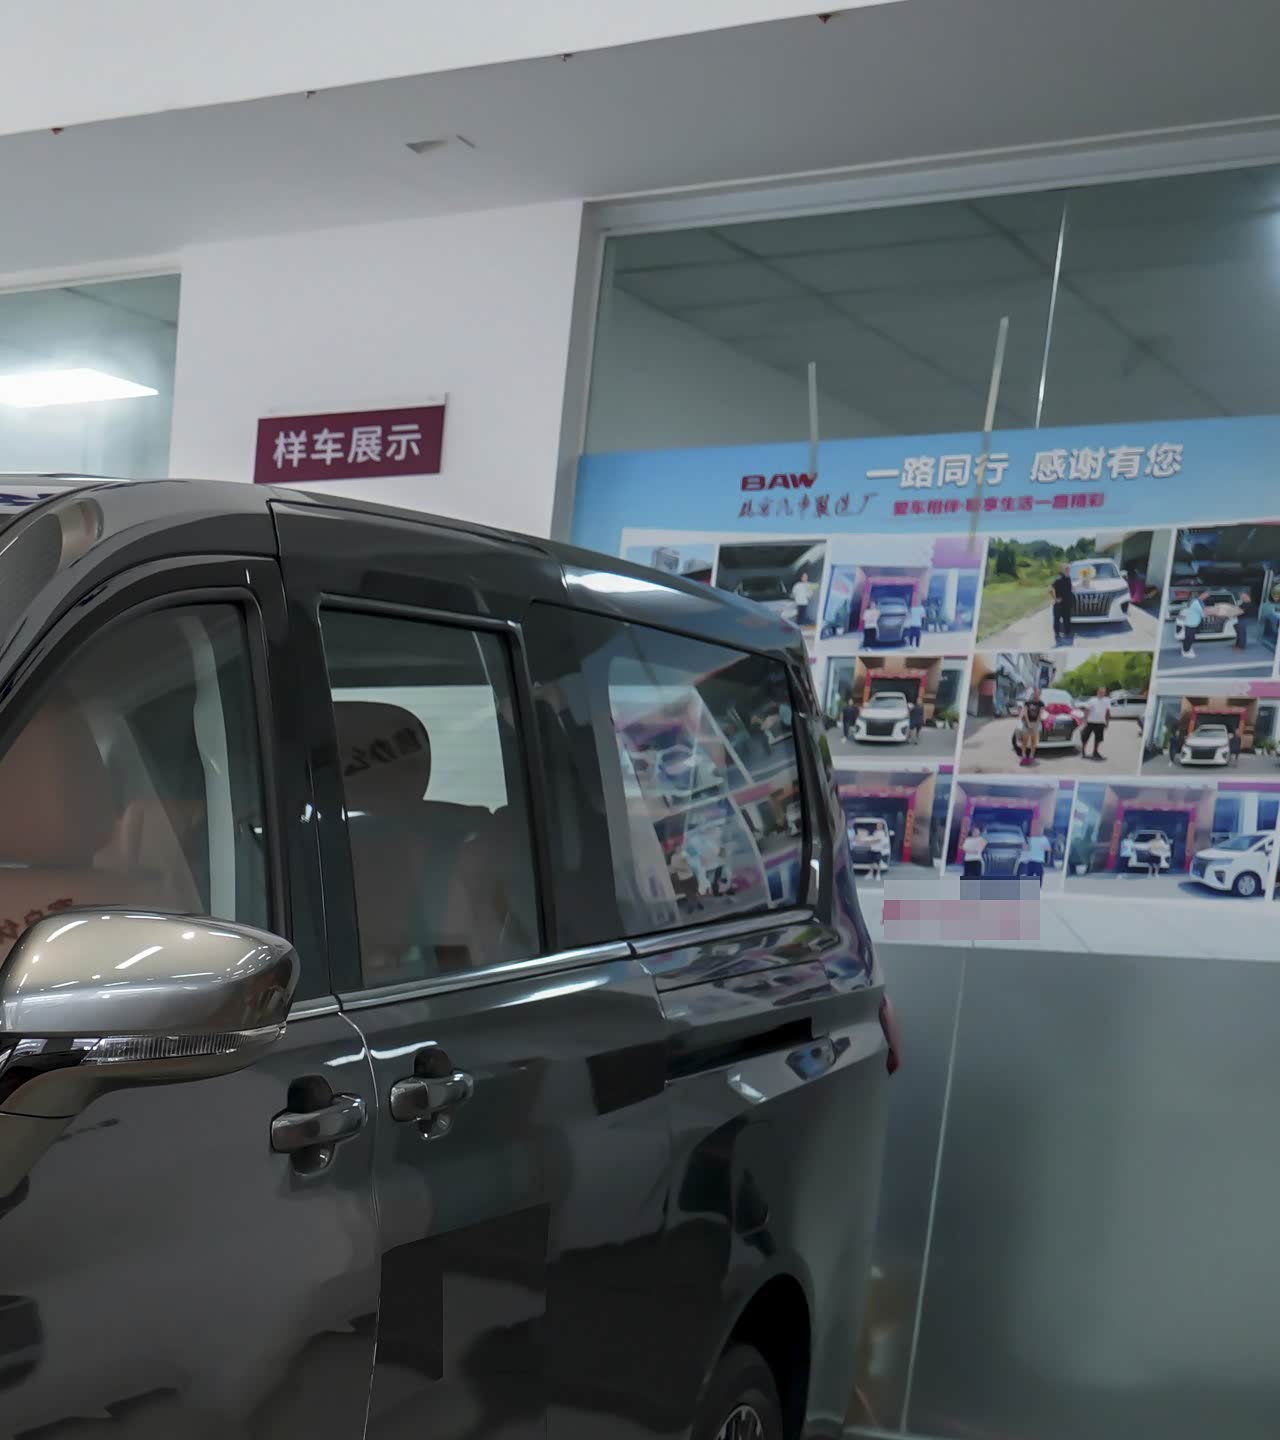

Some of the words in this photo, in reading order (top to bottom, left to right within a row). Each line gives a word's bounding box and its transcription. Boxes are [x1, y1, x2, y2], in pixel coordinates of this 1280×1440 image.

[273, 423, 422, 470] 样车展示
[866, 452, 1009, 488] 一路同行
[1029, 442, 1184, 484] 感谢有您
[741, 472, 818, 492] BAW
